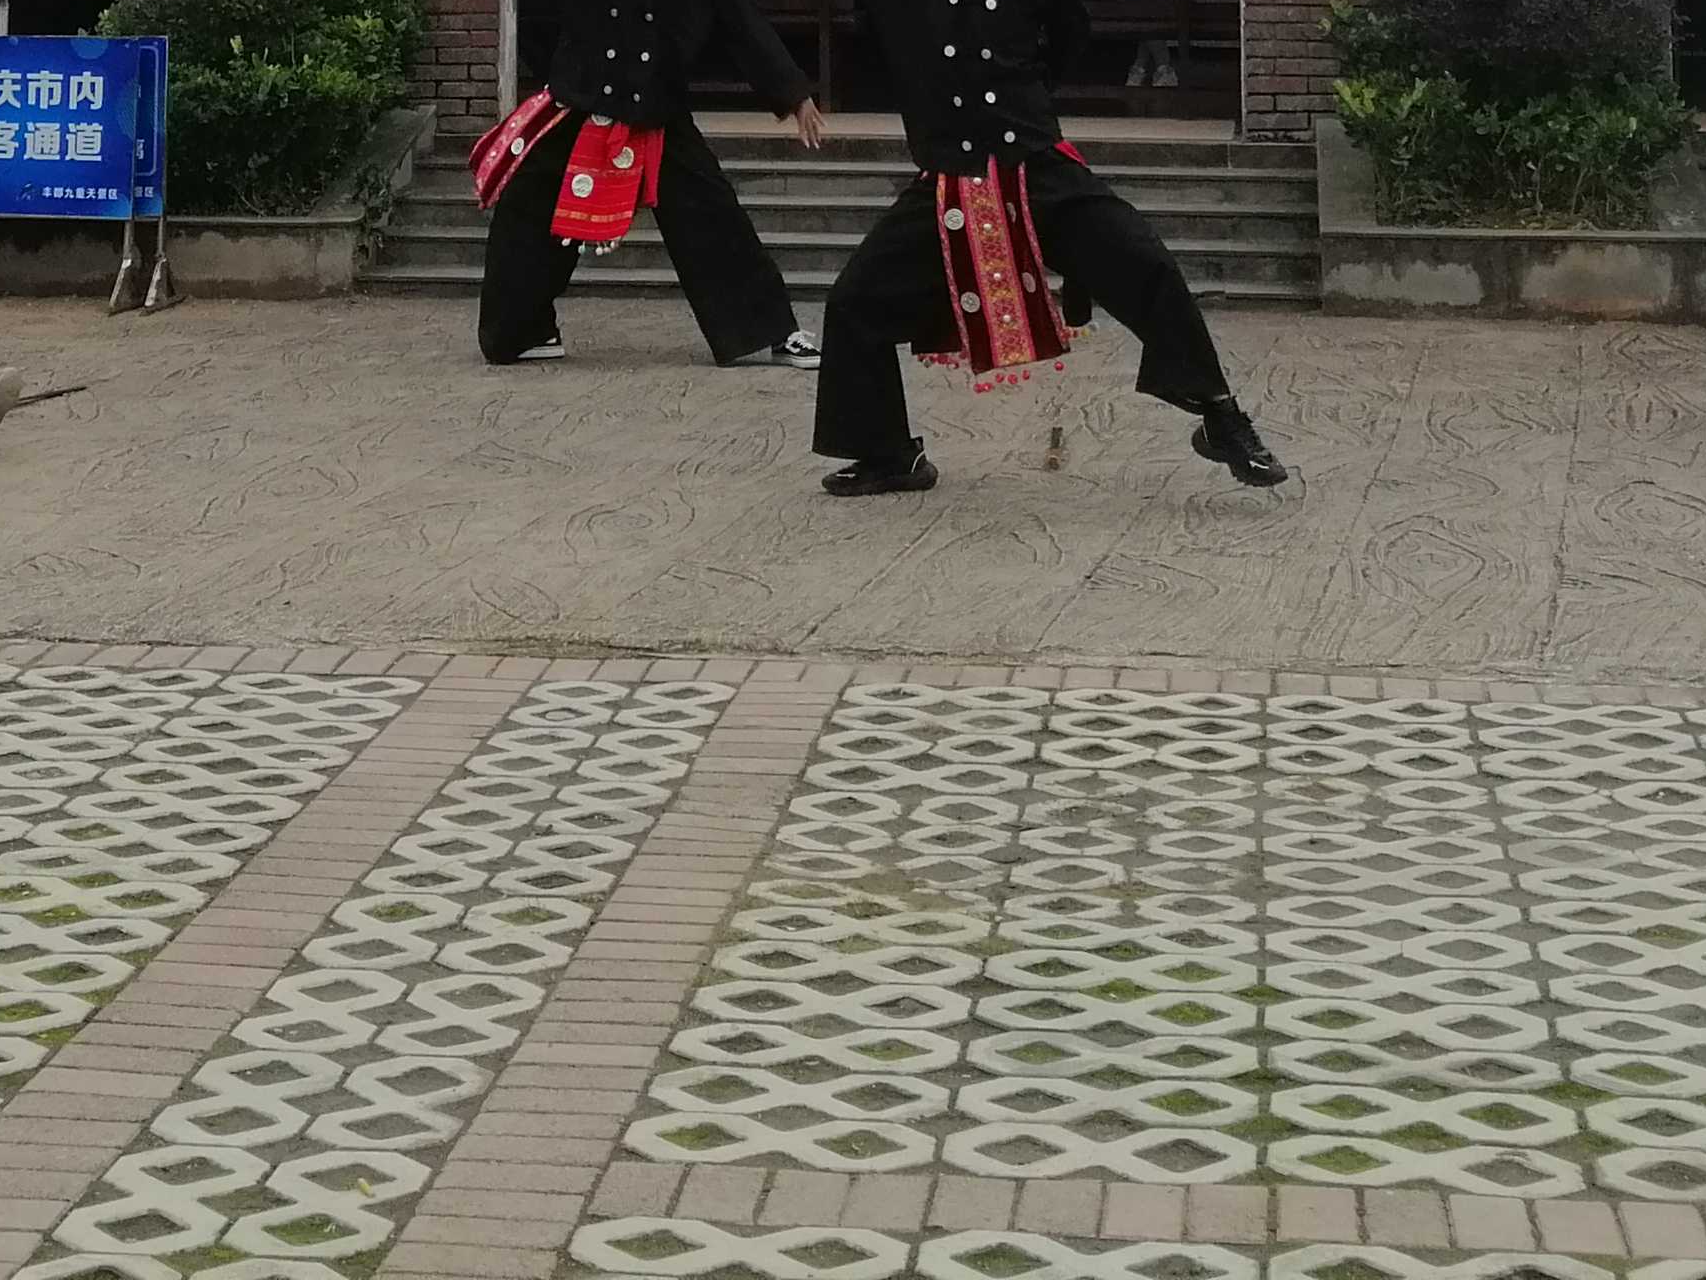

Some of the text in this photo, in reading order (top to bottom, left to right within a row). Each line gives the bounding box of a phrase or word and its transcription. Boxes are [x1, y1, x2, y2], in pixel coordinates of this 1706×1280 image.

[41, 185, 119, 200] 丰都九重天景区
